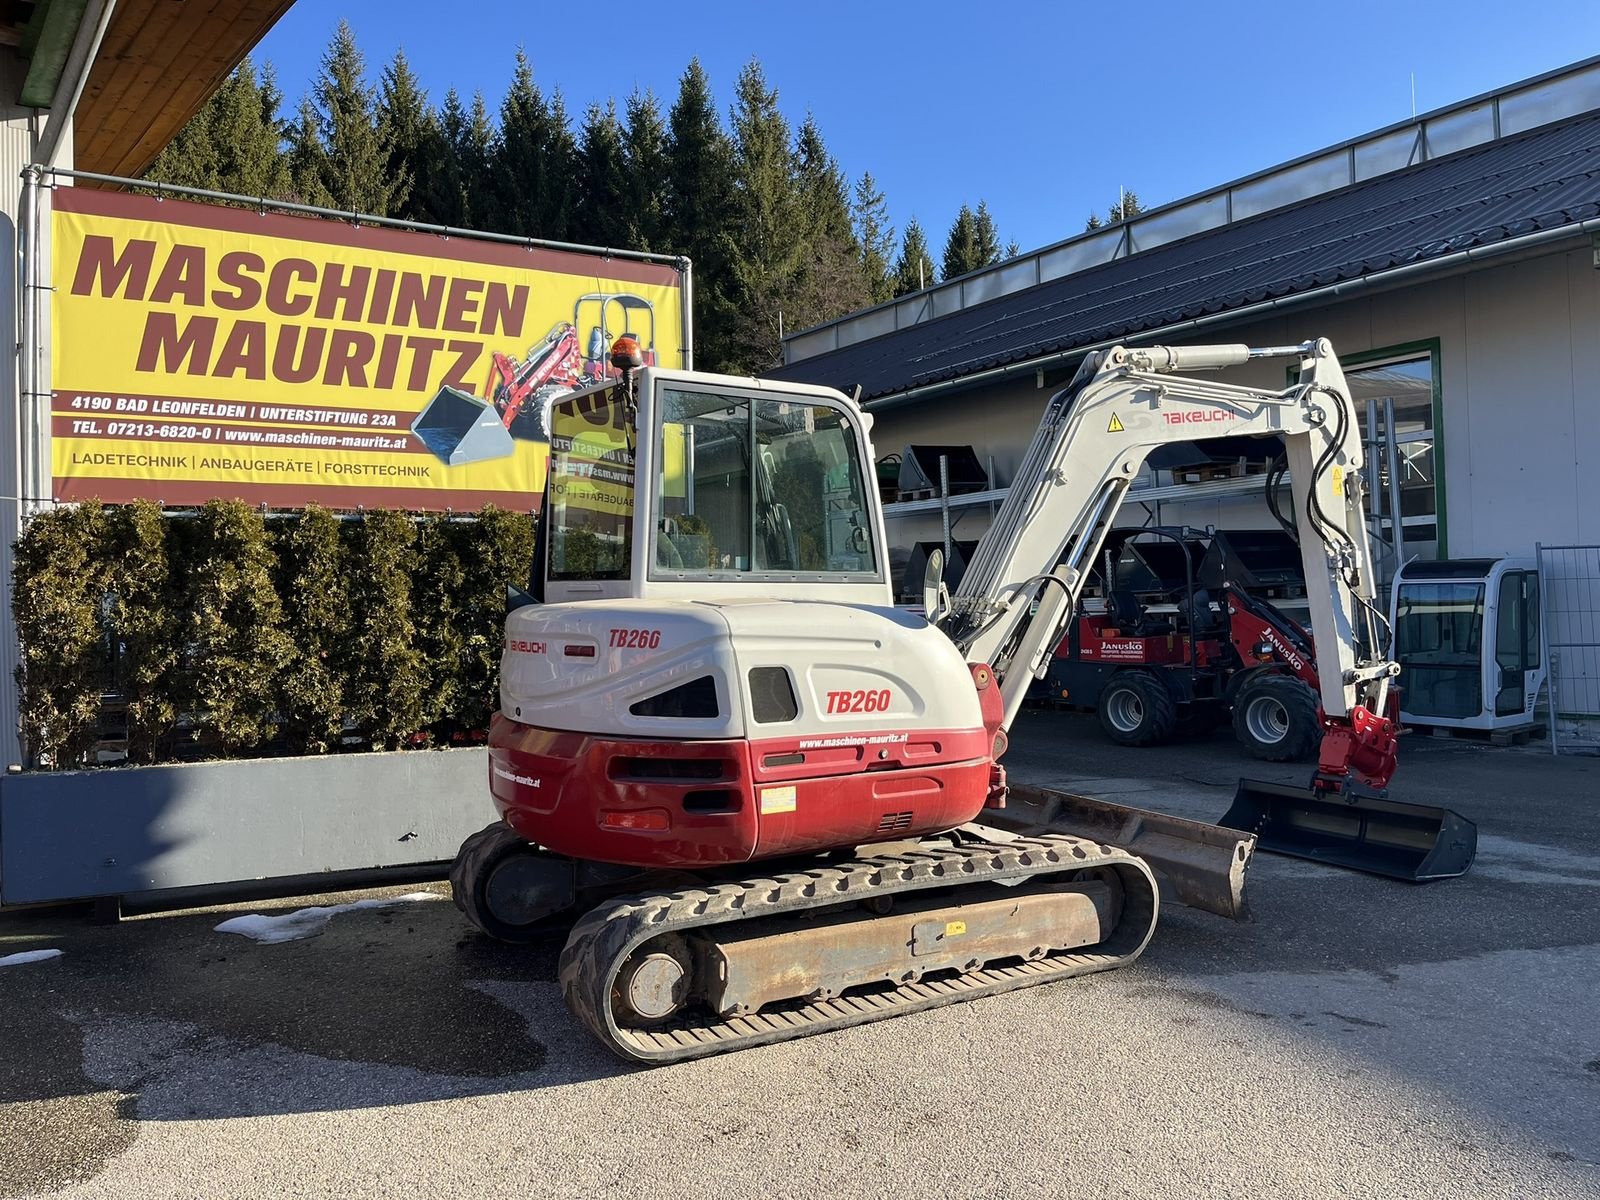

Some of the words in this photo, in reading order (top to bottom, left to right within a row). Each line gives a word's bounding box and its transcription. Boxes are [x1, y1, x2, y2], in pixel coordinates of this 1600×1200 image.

[70, 233, 530, 338] MASCHINEN
[135, 310, 484, 396] MAURITZ
[71, 396, 111, 410] 4190
[115, 398, 148, 412] BAD
[152, 400, 246, 418] LEONFELDEN
[259, 407, 368, 425] UNTERSTIFTUNG
[370, 415, 397, 426] 23A
[1162, 409, 1235, 424] TAKEUCHI
[72, 420, 102, 434] TEL.
[107, 422, 212, 440] 07213-6820-0
[224, 430, 407, 449] www.maschinen-mauritz.at
[72, 453, 187, 468] LADETECHNIK
[200, 457, 313, 473] ANBAUGERÄTE
[324, 463, 430, 477] FORSTTECHNIK
[609, 629, 660, 649] TB260
[826, 689, 892, 714] TB260
[799, 733, 908, 749] www.maschinen-mauritz.at
